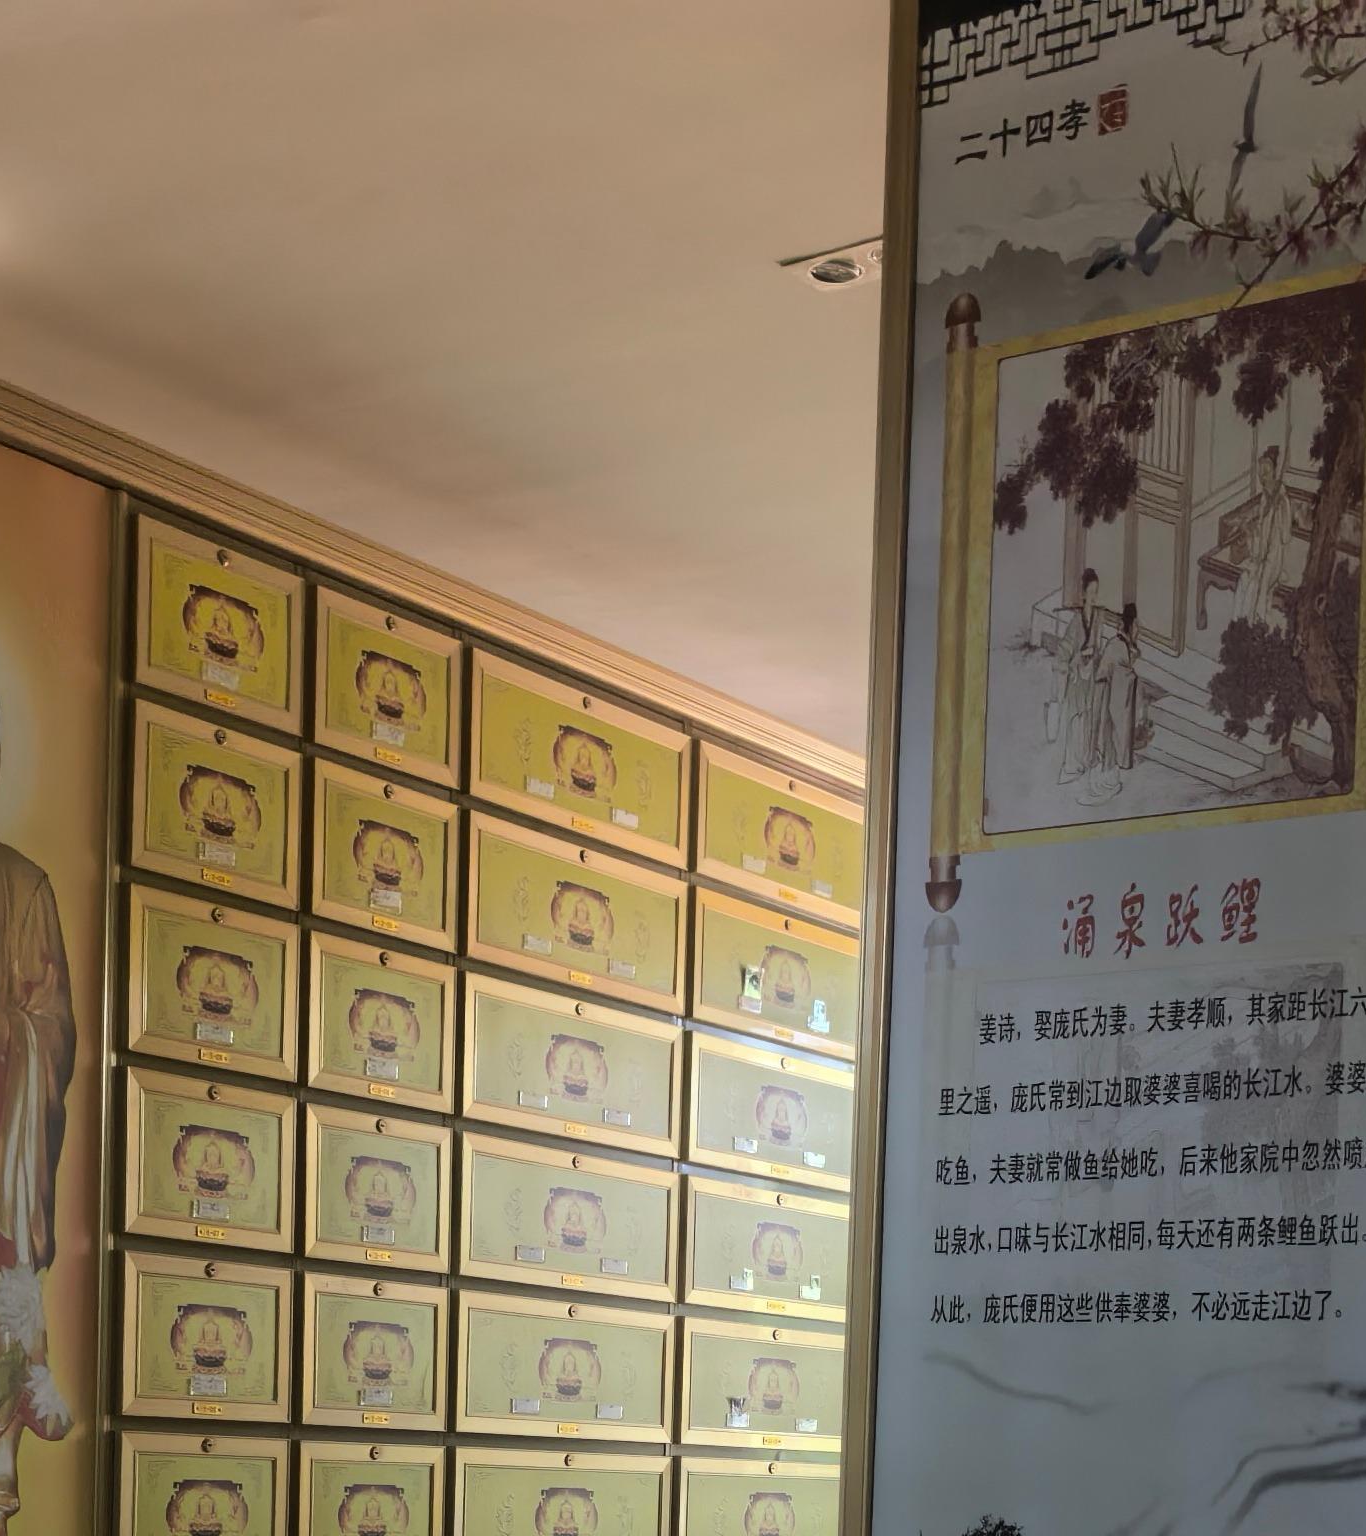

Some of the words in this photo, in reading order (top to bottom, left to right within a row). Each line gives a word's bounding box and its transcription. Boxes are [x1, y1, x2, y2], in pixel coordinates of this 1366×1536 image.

[955, 99, 1090, 165] 二十四孝
[1062, 878, 1261, 959] 涌泉跃鲤
